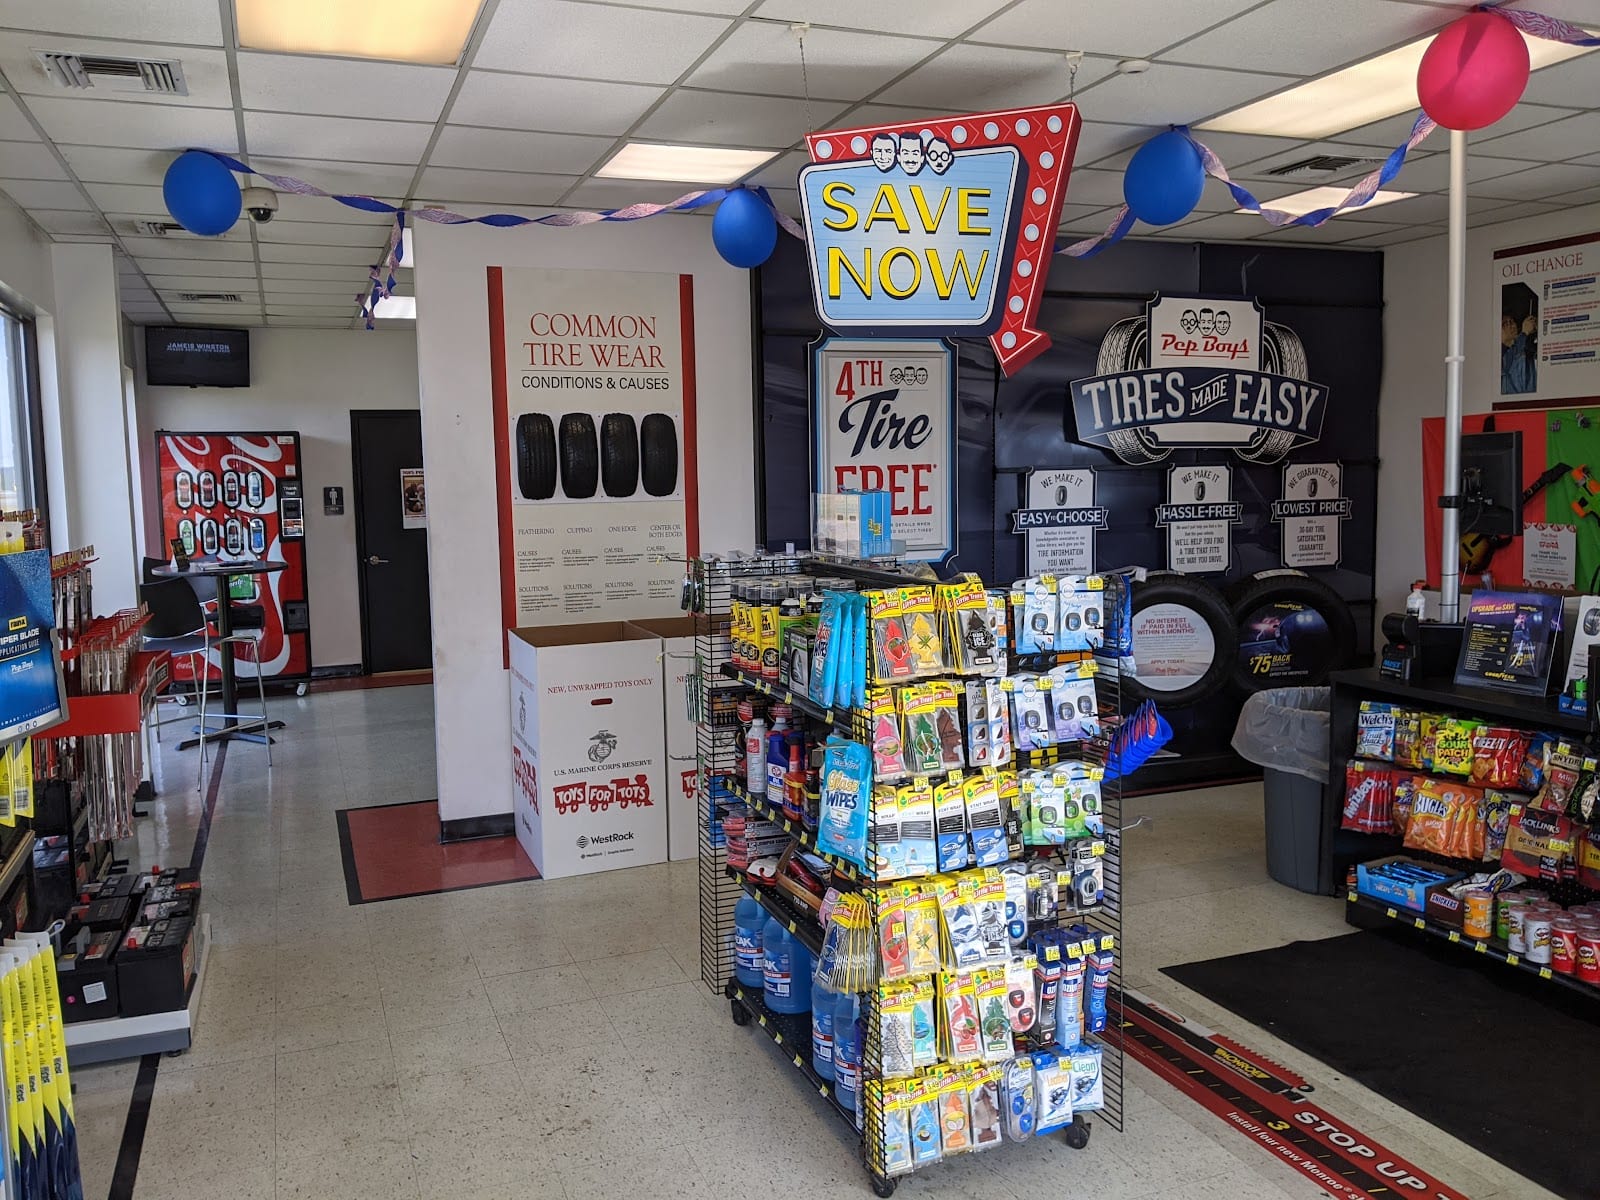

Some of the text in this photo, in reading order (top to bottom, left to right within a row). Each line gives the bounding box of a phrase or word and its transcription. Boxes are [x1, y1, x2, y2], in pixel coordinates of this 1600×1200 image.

[822, 182, 992, 235] SAVE
[1502, 252, 1583, 278] OIL CHANGE
[827, 246, 989, 300] NOW
[530, 313, 656, 338] COMMON
[1161, 333, 1249, 360] Pep Boys
[523, 343, 665, 368] TIRE WEAR
[521, 376, 669, 390] CONDITIONS & CAUSES
[835, 361, 883, 403] 4TH
[1082, 371, 1320, 431] TIRES MADE EASY
[838, 388, 933, 457] Tire
[1041, 473, 1084, 489] WE MAKE IT
[1181, 469, 1220, 484] WE MAKE IT
[1287, 467, 1338, 489] WE GUARANTEE THE
[1277, 501, 1346, 515] LOWEST PRICE
[1019, 512, 1051, 525] EASY
[1056, 510, 1102, 523] CHOOSE
[566, 526, 593, 534] CUPPING
[608, 525, 621, 533] ONE
[1050, 549, 1084, 557] INFORMATION
[1059, 558, 1074, 566] WANT
[519, 585, 549, 593] SOLUTIONS
[563, 583, 592, 591] SOLUTIONS
[874, 602, 887, 614] Little
[902, 596, 930, 609] Little Trees
[955, 596, 969, 606] Little
[1471, 604, 1496, 613] UPGRADE
[1502, 602, 1516, 610] SAVE
[20, 627, 40, 640] BLADE
[25, 639, 40, 650] GUIDE
[972, 637, 986, 646] ICE
[1249, 653, 1293, 674] $75 BACK
[1484, 672, 1515, 680] GOODYEAR
[568, 682, 613, 693] UNWRAPPED
[614, 680, 633, 689] TOYS
[633, 678, 653, 687] ONLY
[1361, 714, 1393, 725] Welch's
[1438, 739, 1468, 749] SOUR
[1438, 748, 1469, 757] PATCH
[568, 766, 596, 775] MARINE
[597, 763, 621, 771] CORPS
[621, 759, 653, 769] RESERVE
[827, 769, 860, 793] Glass
[556, 784, 646, 804] TOYS FOR TOTS
[825, 789, 858, 810] WIPES
[1414, 793, 1448, 816] BUGLES
[1518, 817, 1537, 828] JACK
[591, 831, 634, 845] WestRock
[974, 888, 989, 899] Little
[904, 895, 919, 907] Little
[1432, 893, 1458, 910] SNICKERS
[958, 977, 972, 987] Trees
[977, 979, 1005, 995] Little Trees
[1072, 1060, 1097, 1073] Clean
[1267, 1120, 1291, 1131] 3
[1226, 1111, 1259, 1134] Install
[1256, 1128, 1276, 1147] four
[1275, 1141, 1302, 1163] new
[1293, 1110, 1428, 1192] STOP UP
